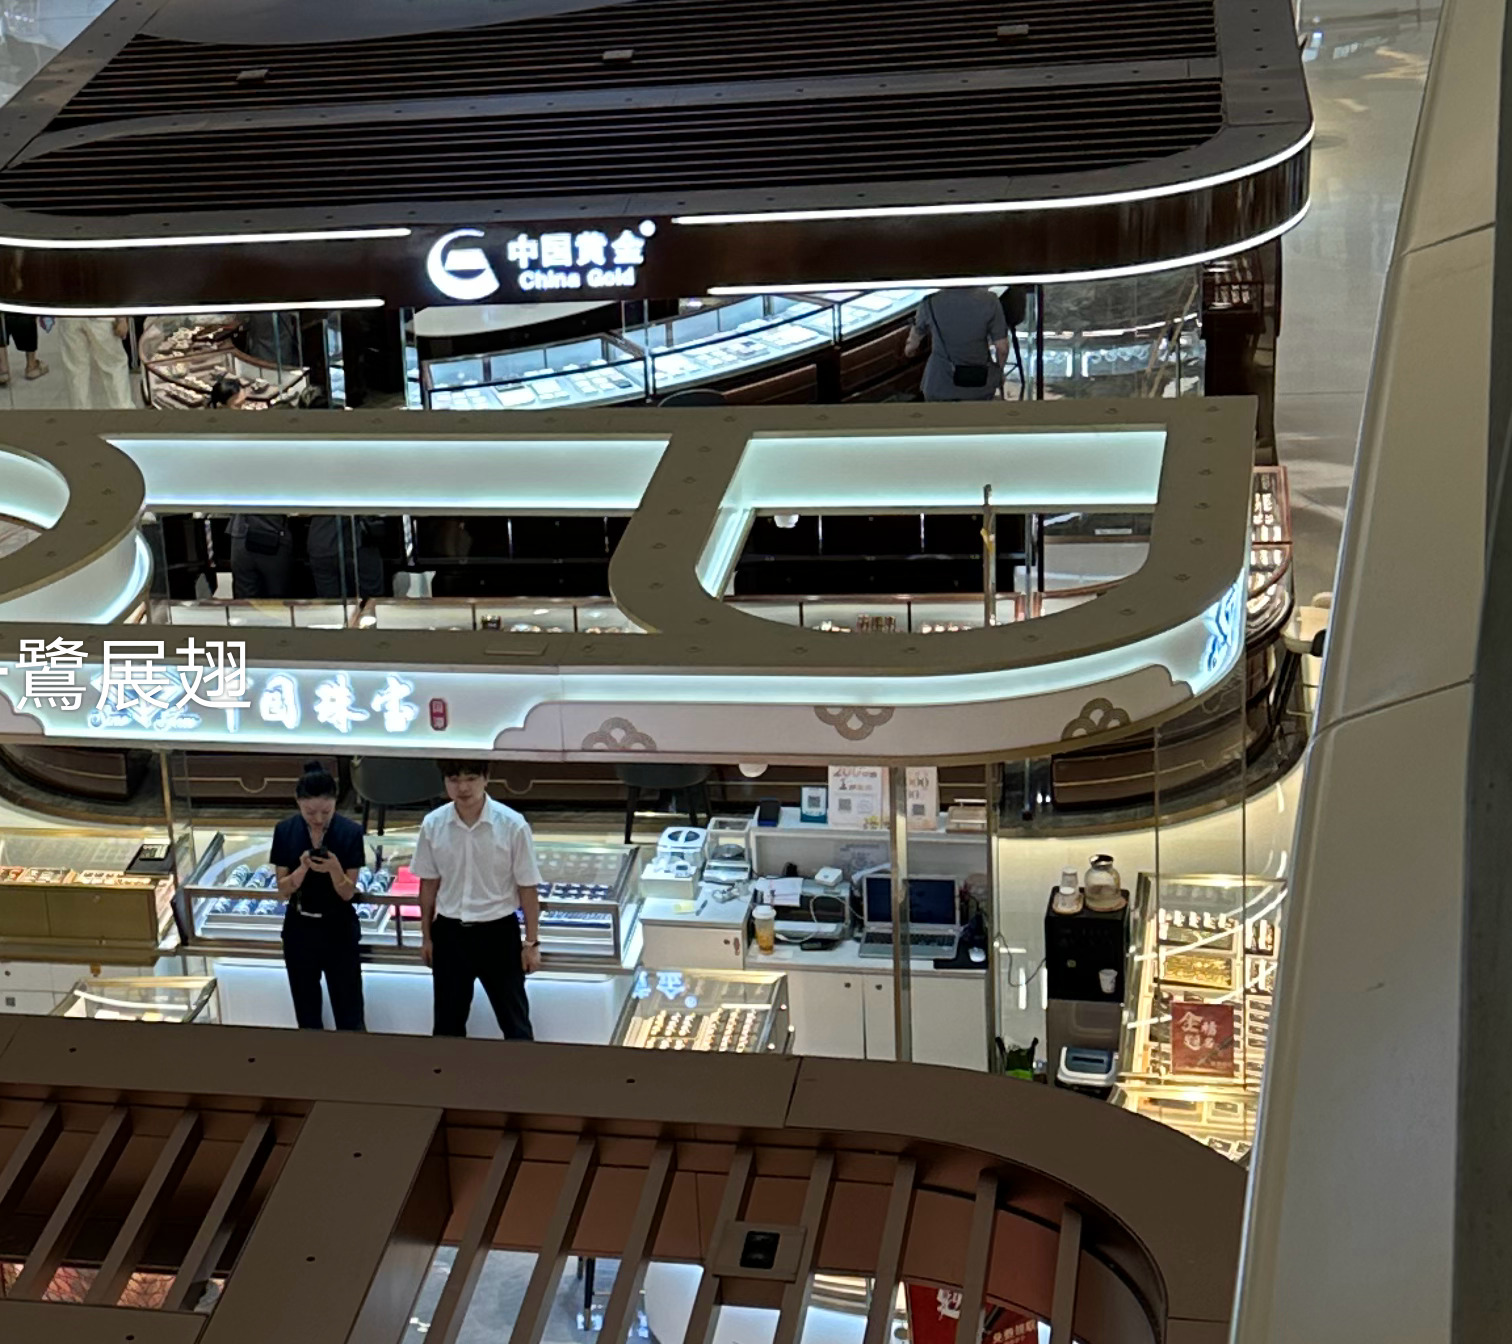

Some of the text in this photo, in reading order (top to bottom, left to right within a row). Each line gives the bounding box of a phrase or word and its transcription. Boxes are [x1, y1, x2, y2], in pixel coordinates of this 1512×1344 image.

[507, 229, 646, 270] 中国黄金
[517, 266, 635, 292] China Gold
